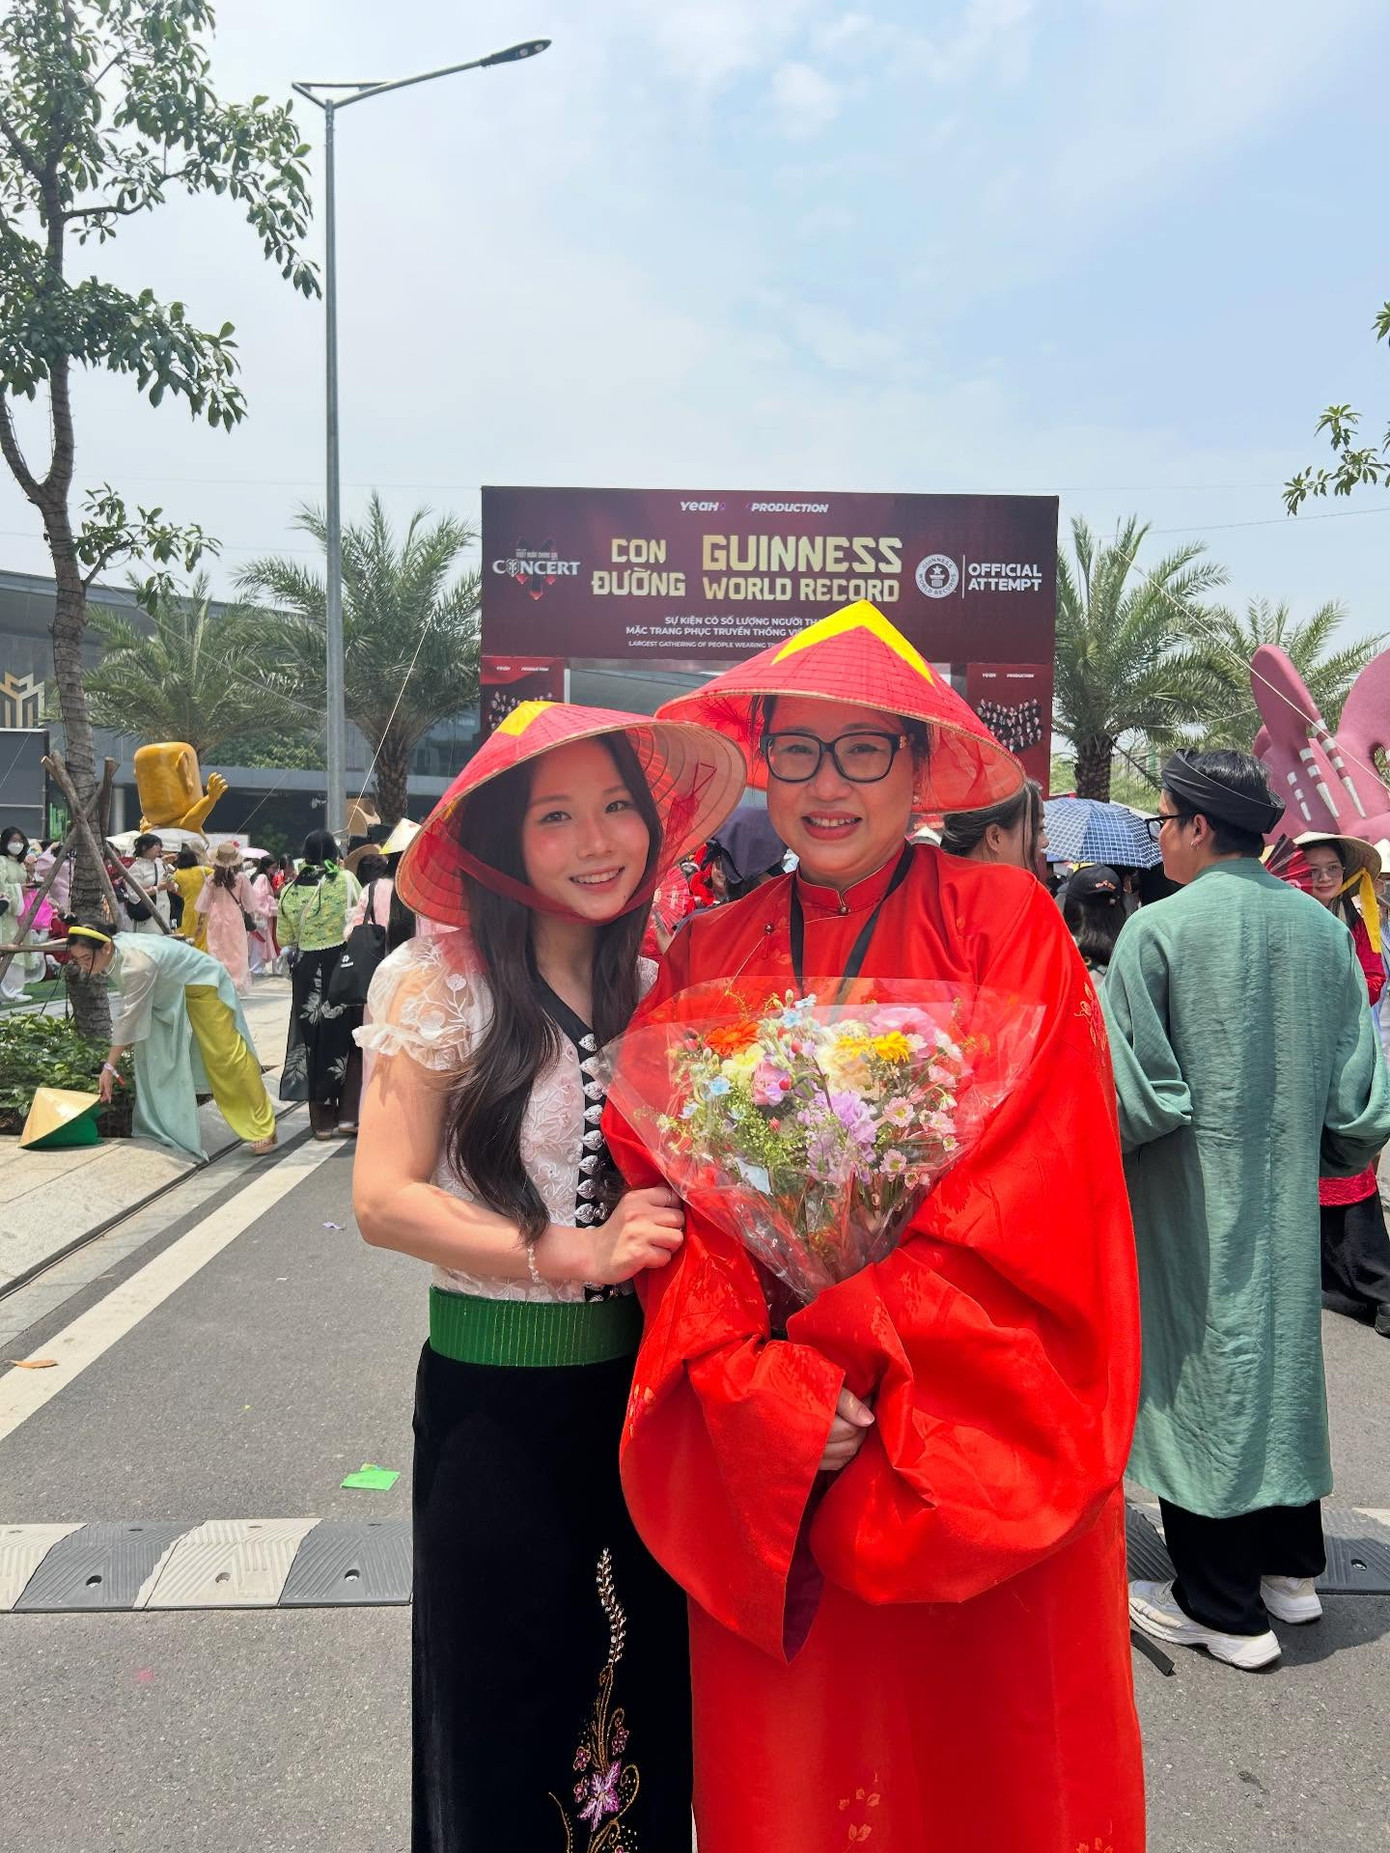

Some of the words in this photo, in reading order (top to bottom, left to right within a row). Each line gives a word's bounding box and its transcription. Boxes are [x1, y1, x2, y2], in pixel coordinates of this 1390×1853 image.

[751, 502, 829, 513] PRODUCTION
[611, 538, 667, 564] CON
[702, 534, 903, 574] GUINNESS
[968, 562, 1042, 577] OFFICIAL
[591, 567, 686, 597] ĐƯỜNG
[702, 576, 792, 601] WORLD
[800, 577, 900, 602] RECORD
[968, 577, 1042, 592] ATTEMPT
[664, 615, 679, 626] SỰ
[649, 626, 683, 635] TRANG
[684, 627, 711, 637] PHỤC
[628, 640, 658, 648] LARGEST
